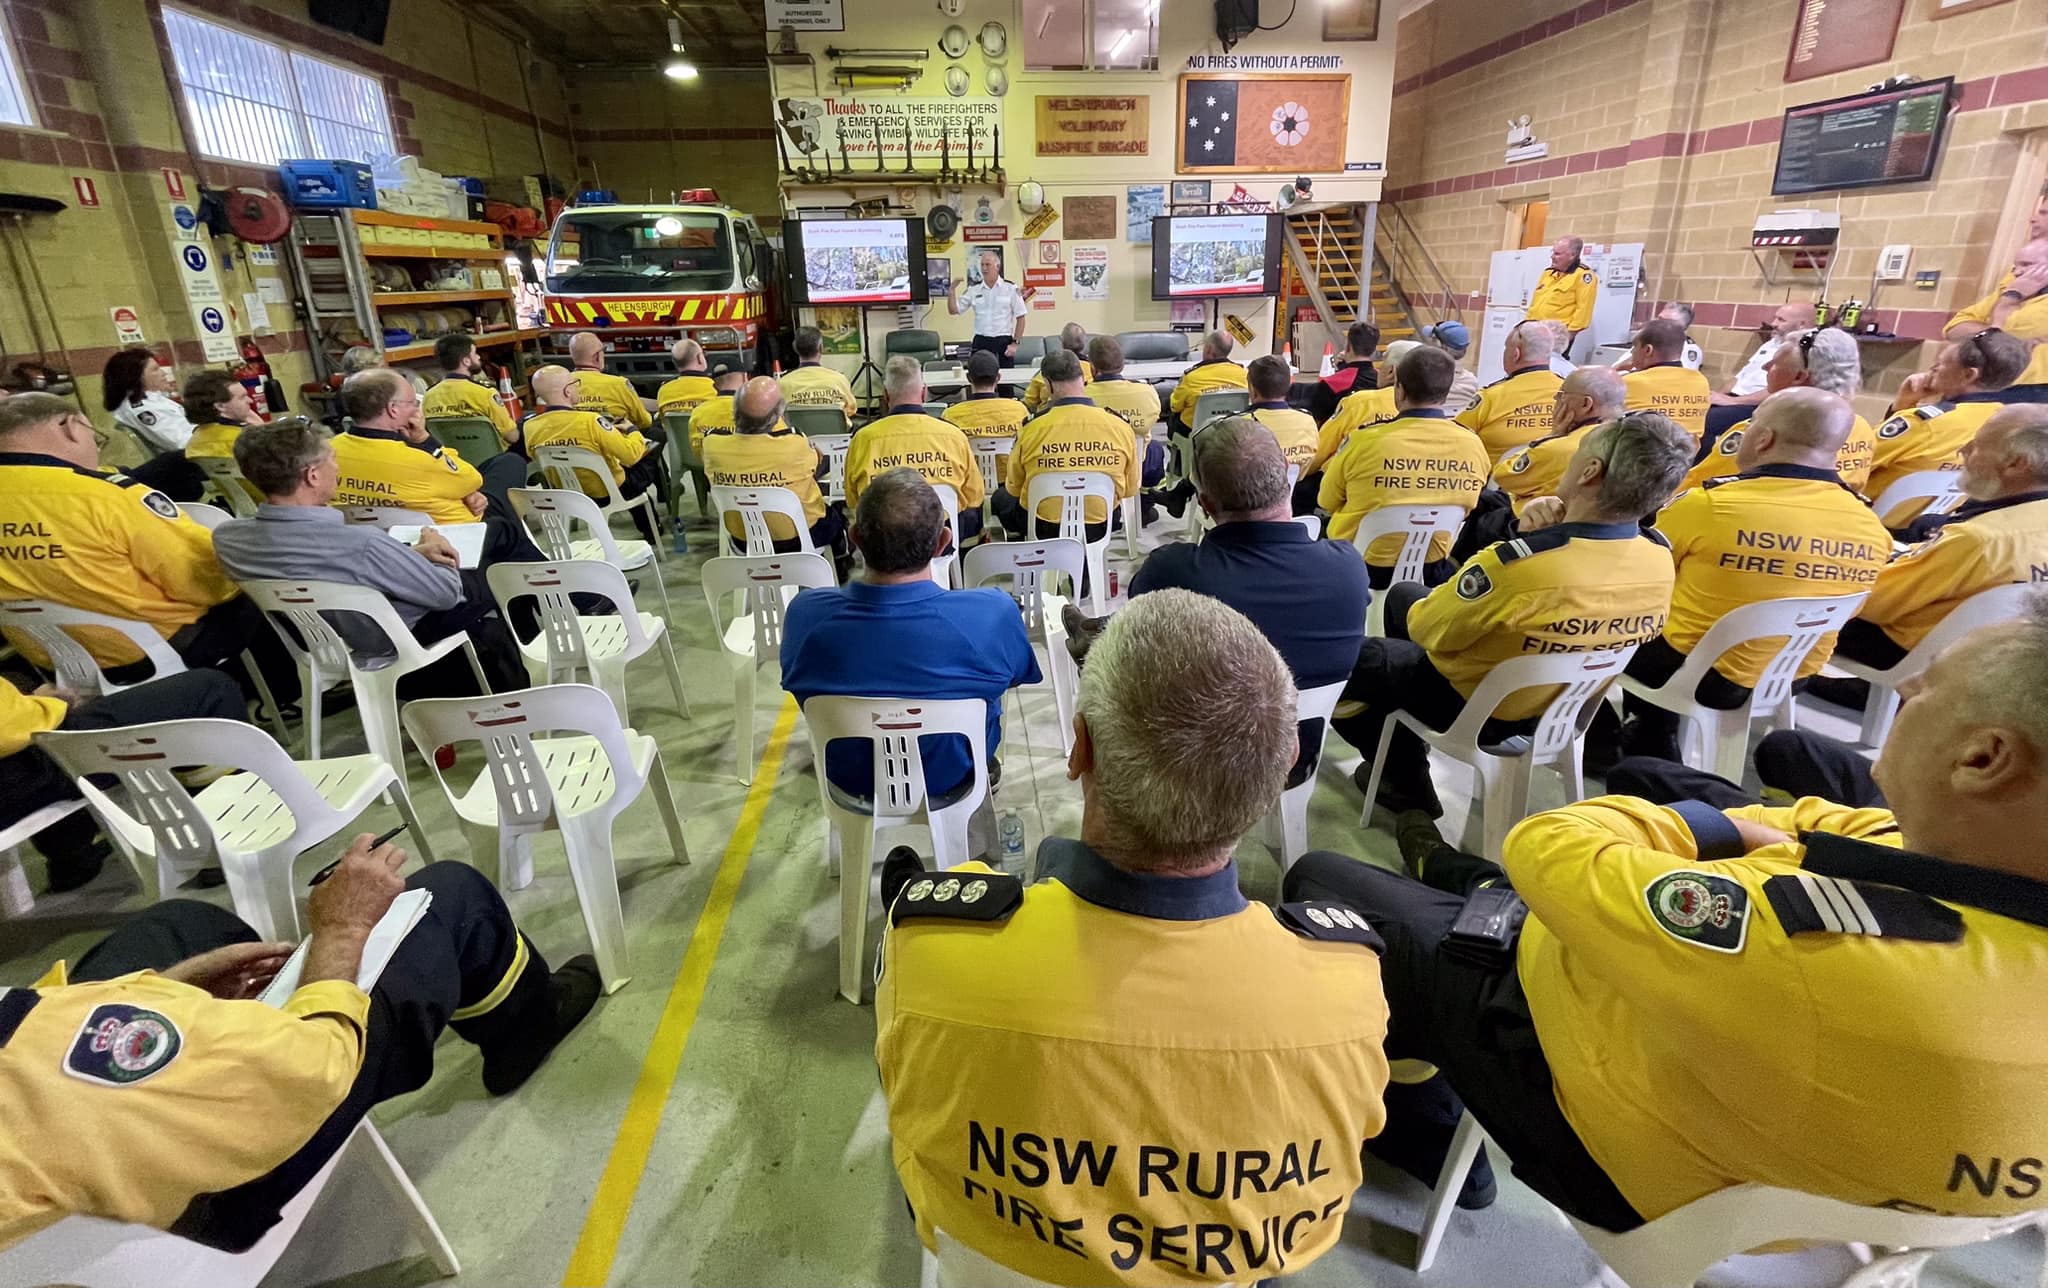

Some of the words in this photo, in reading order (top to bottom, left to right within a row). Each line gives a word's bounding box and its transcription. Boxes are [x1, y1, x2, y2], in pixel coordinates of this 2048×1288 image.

[1188, 56, 1205, 68] NO
[1208, 56, 1237, 68] FIRES
[1240, 56, 1289, 68] WITHOUT
[1290, 56, 1298, 68] A
[1300, 56, 1340, 68] PERMIT
[823, 98, 866, 115] Thanks
[869, 104, 883, 114] TO
[885, 104, 903, 114] ALL
[906, 104, 926, 113] THE
[928, 104, 998, 113] FIREFIGHTERS
[848, 116, 910, 126] EMERGENCY
[914, 116, 962, 126] SERVICES
[964, 116, 984, 126] FOR
[836, 129, 872, 139] SAVING
[916, 128, 960, 138] WILDLFE
[963, 128, 989, 138] PRK
[867, 141, 895, 151] frm
[914, 140, 932, 151] the
[934, 139, 984, 151] Aimls
[608, 301, 671, 312] HELENSBURGH
[615, 335, 675, 343] CANTER
[1652, 395, 1680, 404] NSW
[1683, 395, 1708, 404] RURA
[1117, 408, 1142, 417] URAL
[1514, 405, 1542, 415] NSW
[985, 424, 1018, 434] RURAL
[1506, 418, 1535, 428] FIRE
[1042, 443, 1071, 454] NSW
[1075, 441, 1116, 452] RURAL
[873, 455, 902, 469] NSW
[906, 451, 949, 465] RURAL
[1038, 458, 1066, 468] FIRE
[1069, 456, 1120, 467] SERVICE
[1383, 459, 1421, 471] NSW
[1425, 459, 1477, 474] RURAL
[713, 472, 737, 483] NSW
[740, 471, 786, 484] RURAL
[917, 466, 952, 478] RVICE
[346, 478, 397, 495] RURAL
[1374, 476, 1412, 489] FIRE
[1416, 478, 1479, 492] SERVICE
[2, 522, 52, 537] RAL
[1736, 529, 1803, 552] NSW
[1810, 538, 1876, 561] RURAL
[0, 544, 66, 560] RVICE
[1719, 553, 1785, 575] FIRE
[1794, 562, 1879, 582] SERVICE
[1543, 617, 1607, 636] NSW
[1608, 614, 1665, 635] RURA
[967, 1120, 1118, 1189] NSW
[1138, 1138, 1332, 1200] RURAL
[1946, 1152, 2043, 1198] NS
